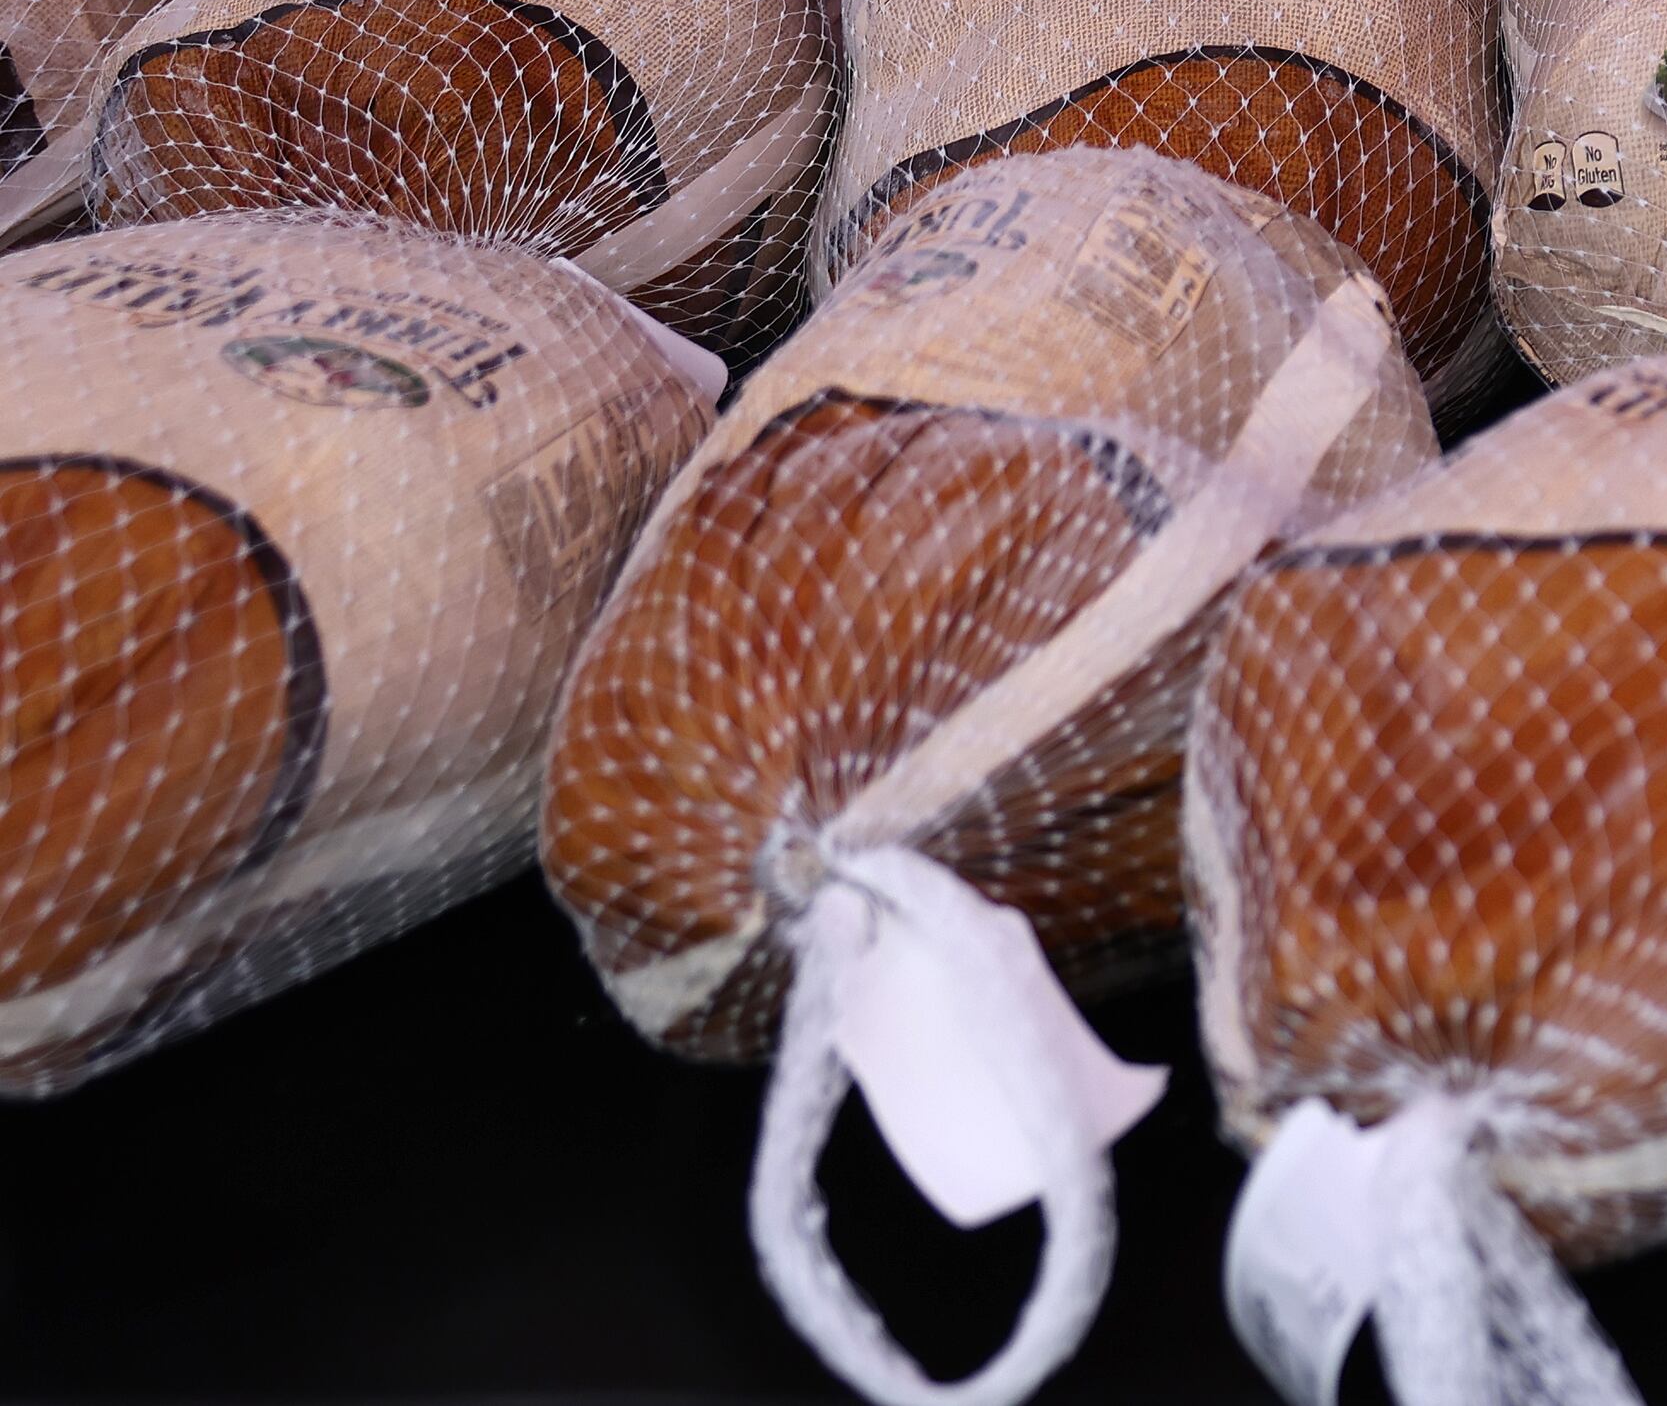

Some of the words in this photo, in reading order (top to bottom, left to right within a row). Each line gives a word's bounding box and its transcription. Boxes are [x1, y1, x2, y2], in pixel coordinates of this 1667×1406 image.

[1543, 154, 1558, 171] No
[1585, 146, 1602, 163] No
[1577, 168, 1617, 185] Gluten
